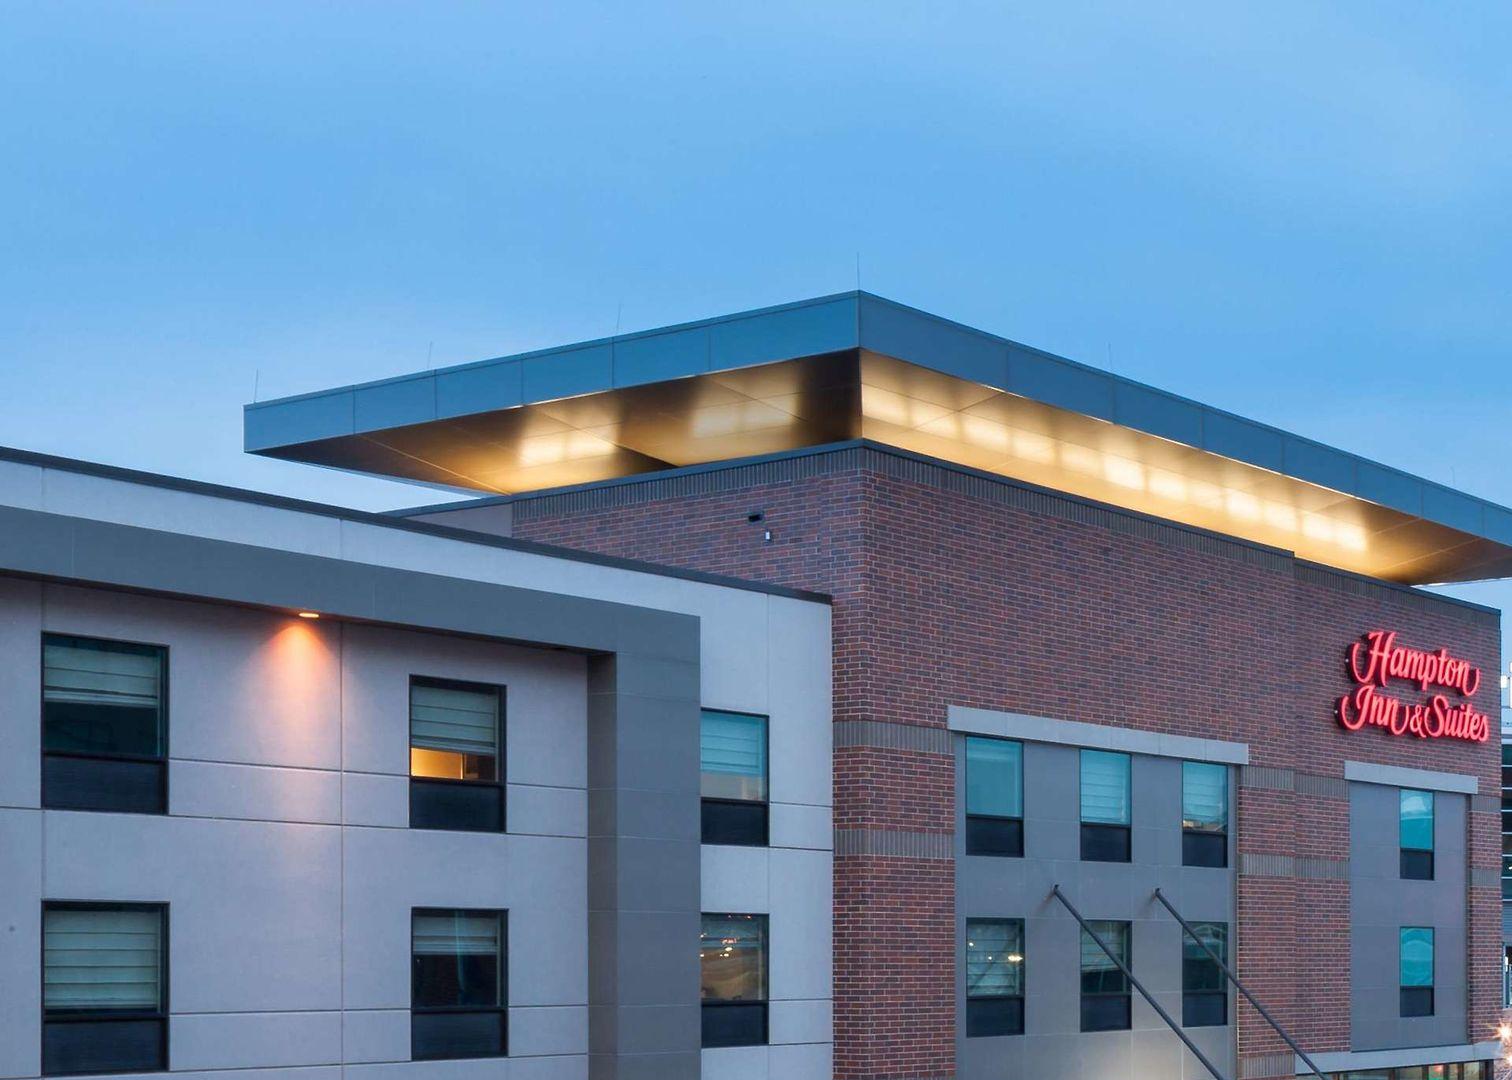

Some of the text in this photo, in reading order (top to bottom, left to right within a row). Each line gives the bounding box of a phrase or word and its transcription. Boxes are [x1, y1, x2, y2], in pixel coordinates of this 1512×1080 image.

[1351, 631, 1480, 697] Hampton
[1341, 684, 1410, 735] Inn
[1423, 694, 1490, 742] Suites
